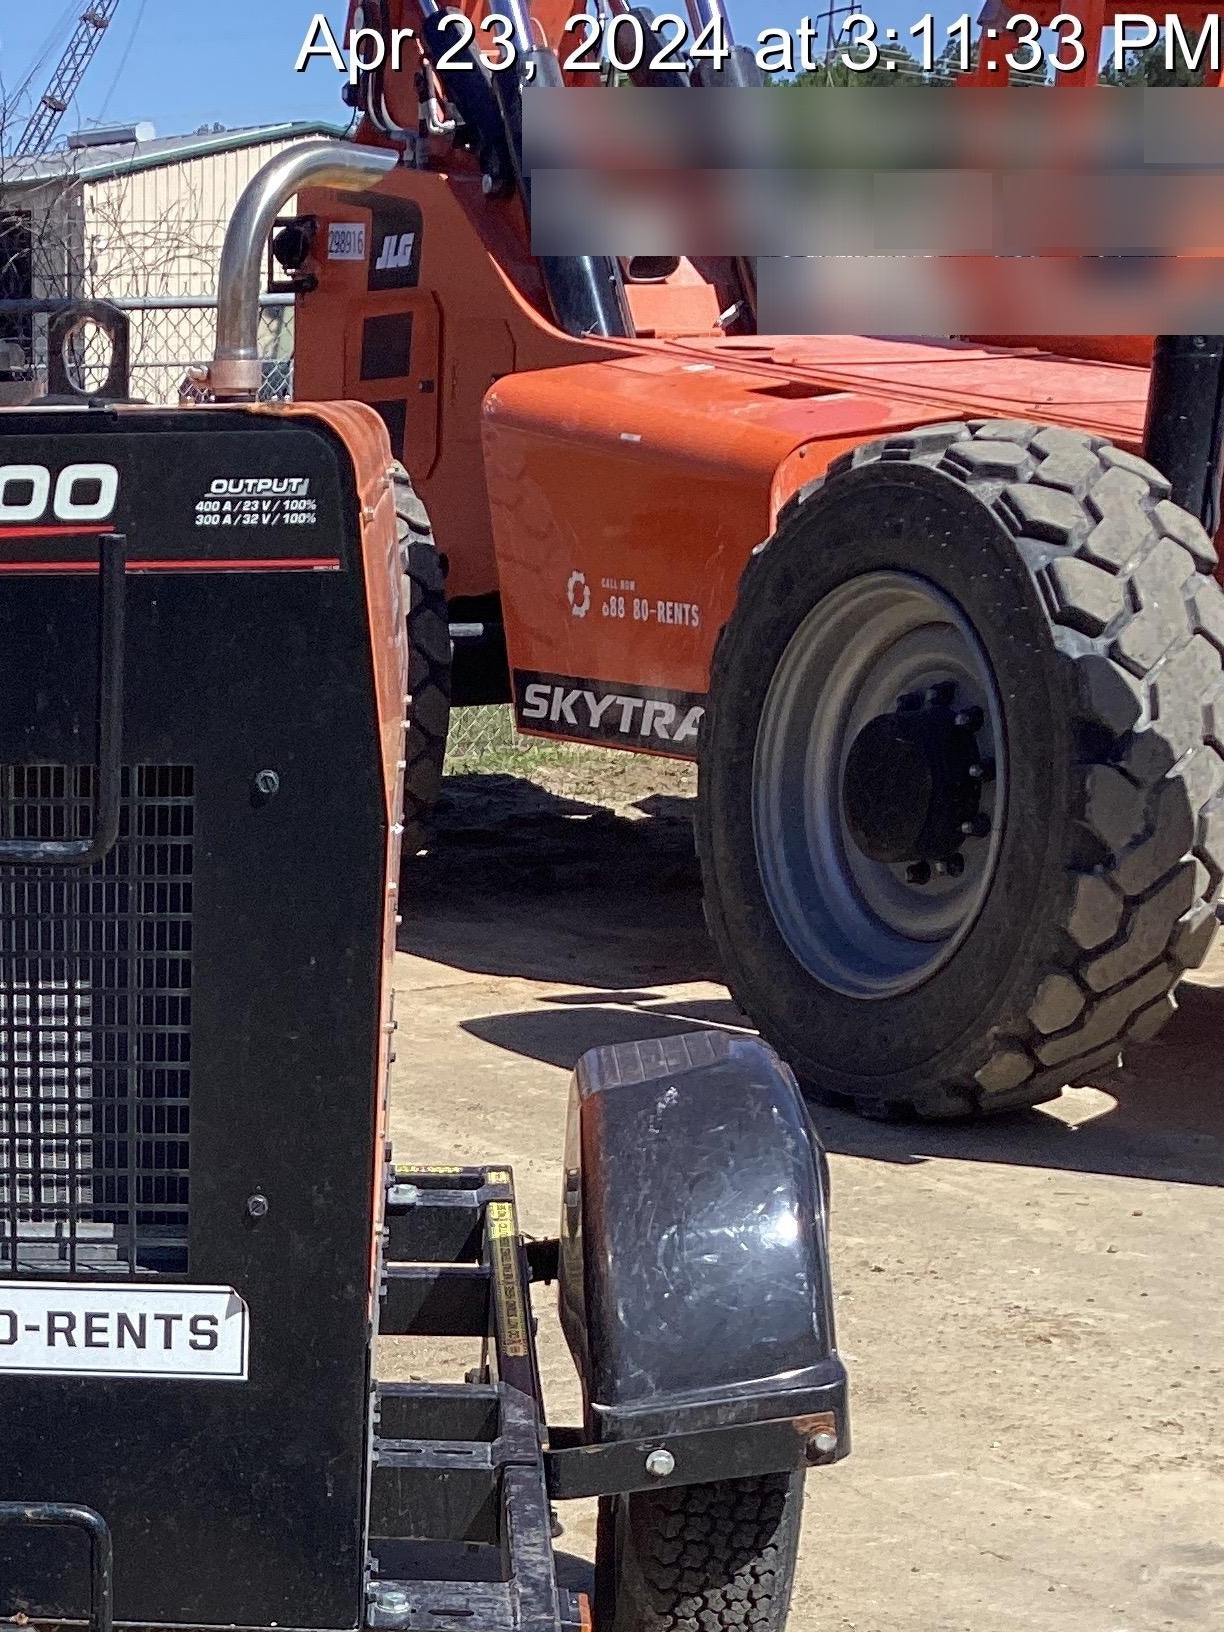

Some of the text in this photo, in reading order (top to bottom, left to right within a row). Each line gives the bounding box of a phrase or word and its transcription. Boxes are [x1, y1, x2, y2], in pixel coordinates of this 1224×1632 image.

[376, 232, 415, 269] JLG
[210, 478, 303, 494] OUTPUT
[195, 500, 221, 512] 400
[283, 499, 317, 511] 100%
[195, 514, 221, 525] 300
[283, 512, 317, 524] 100%
[633, 598, 699, 627] 80-RENTS
[522, 683, 706, 742] SKYTRA
